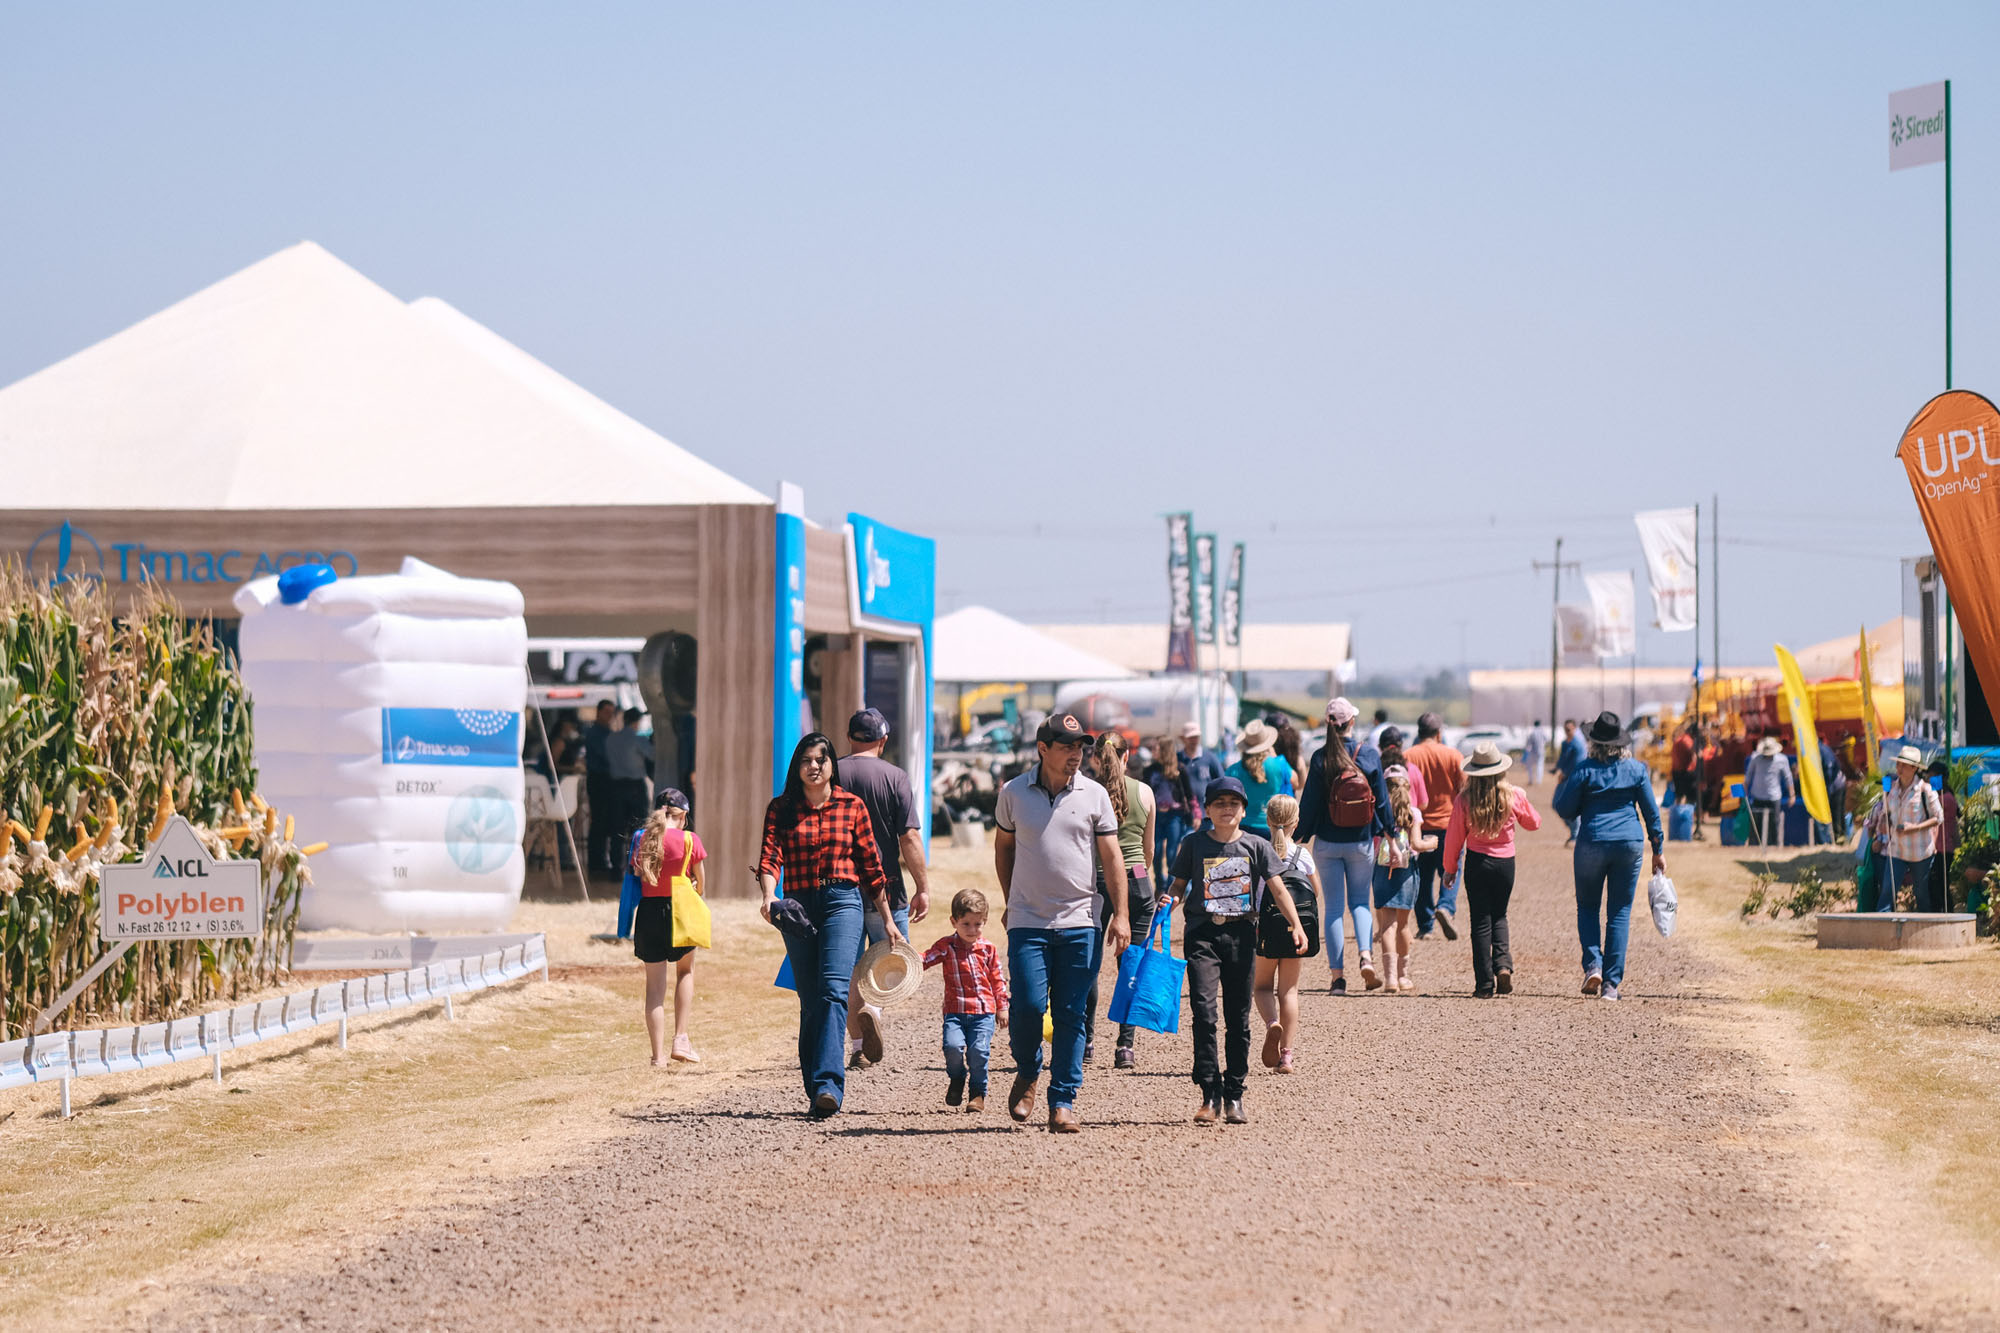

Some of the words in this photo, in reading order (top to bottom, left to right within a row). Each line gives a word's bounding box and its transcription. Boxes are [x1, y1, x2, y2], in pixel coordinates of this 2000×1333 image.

[1906, 108, 1944, 140] Sicredi
[1917, 425, 2000, 478] UPL
[110, 542, 243, 583] Timac
[178, 859, 209, 878] ICL
[118, 891, 245, 921] Polyblen
[131, 921, 151, 933] Fast
[153, 921, 165, 933] 26
[167, 920, 178, 932] 12
[181, 920, 191, 932] 12
[206, 919, 220, 934] (S)
